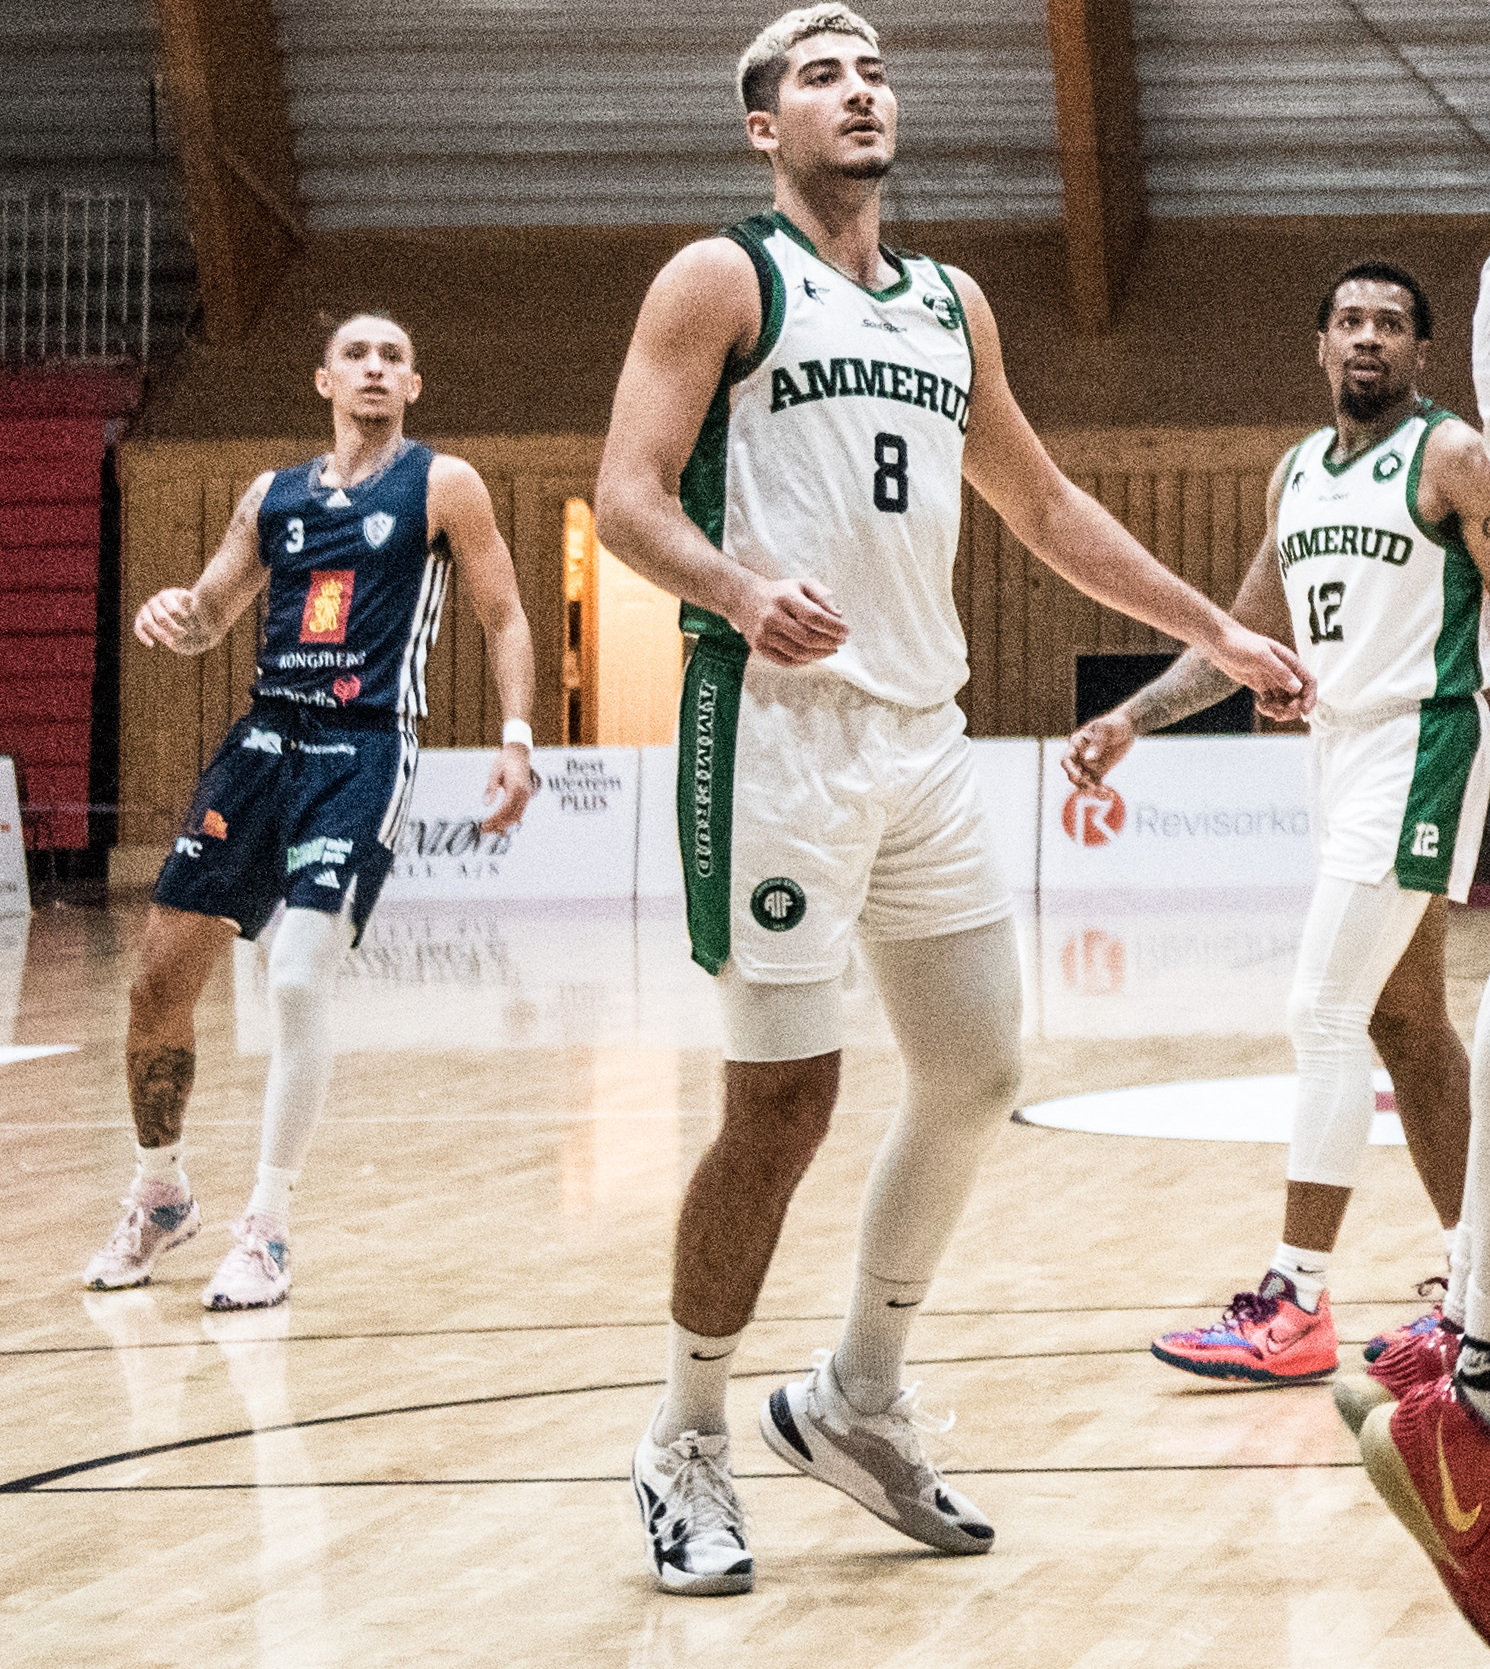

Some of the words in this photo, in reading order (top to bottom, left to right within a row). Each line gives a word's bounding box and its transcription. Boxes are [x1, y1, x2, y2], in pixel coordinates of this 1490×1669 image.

[873, 432, 908, 514] 8
[286, 517, 304, 553] 3
[1308, 581, 1346, 645] 12
[560, 793, 608, 811] PLUS
[1411, 822, 1439, 858] 12
